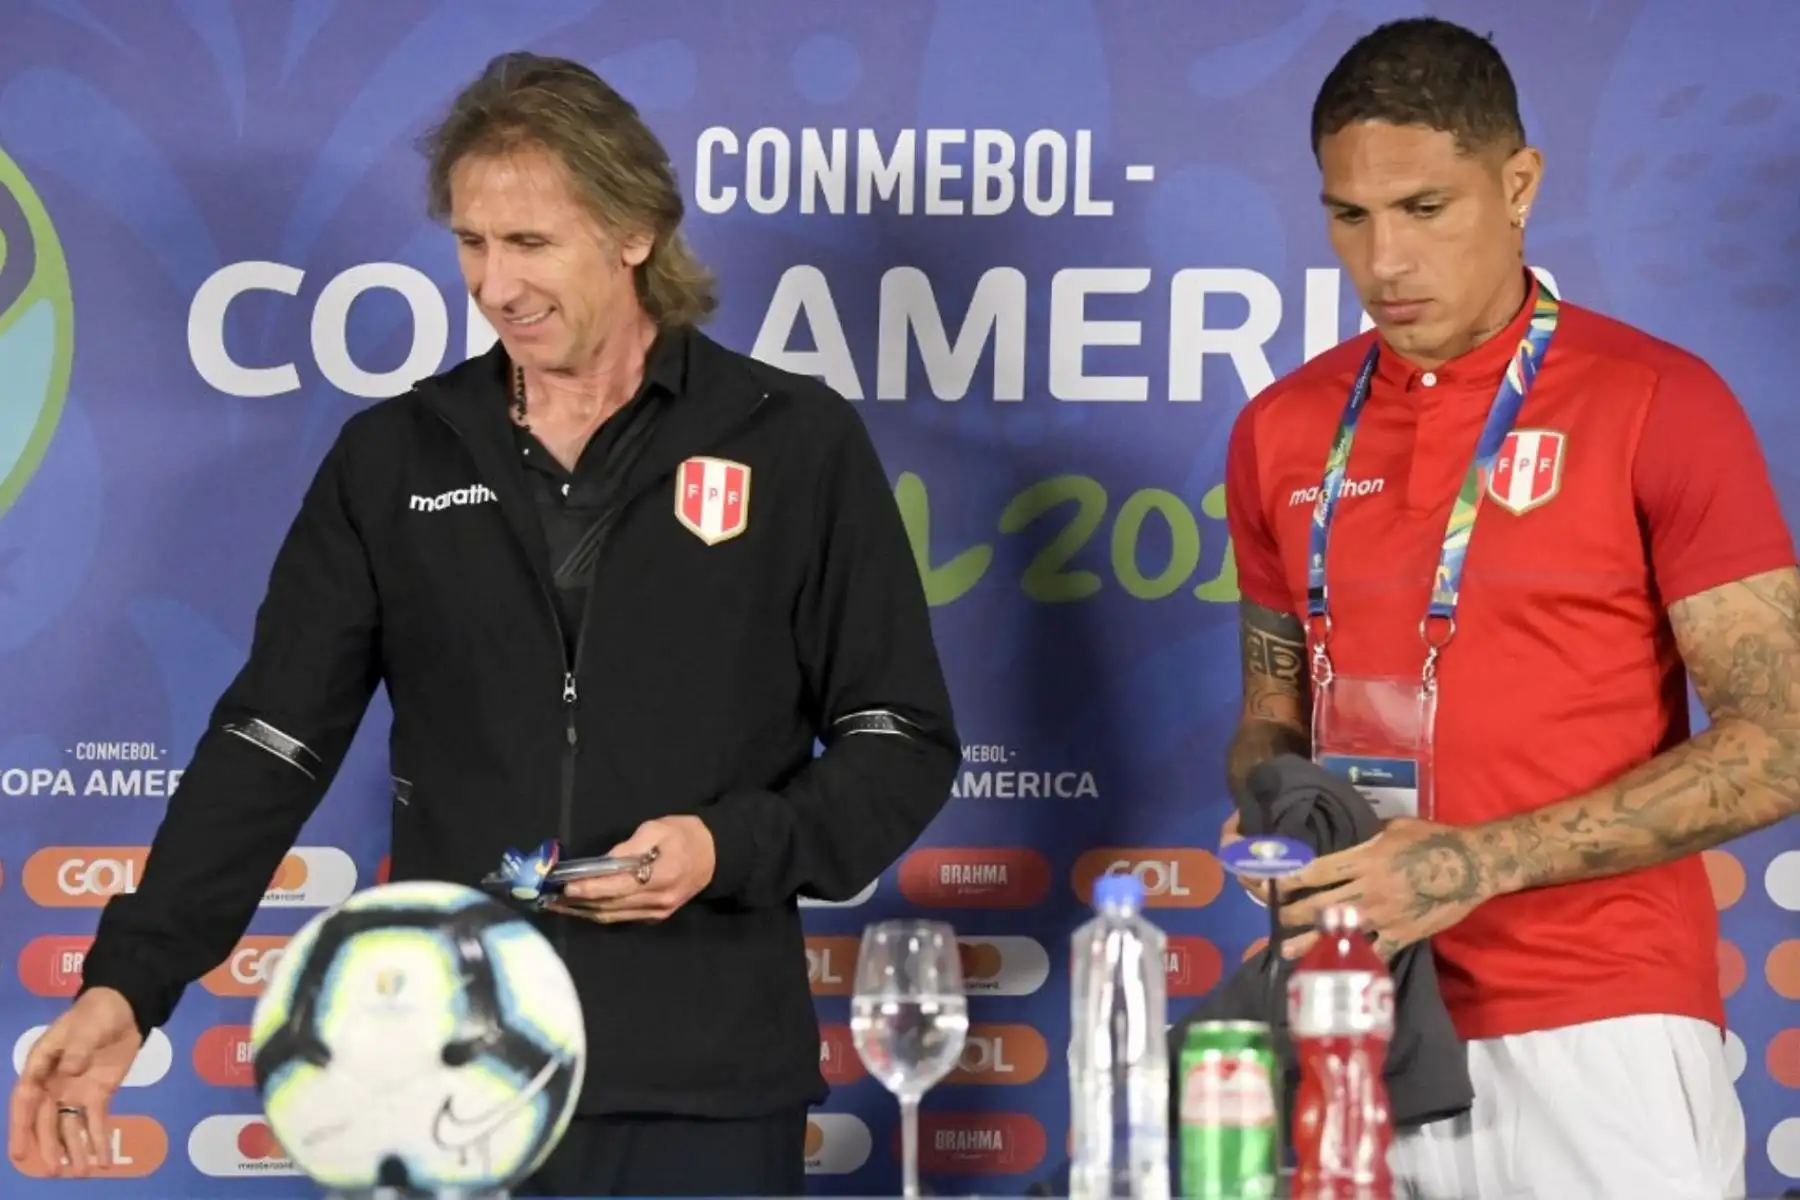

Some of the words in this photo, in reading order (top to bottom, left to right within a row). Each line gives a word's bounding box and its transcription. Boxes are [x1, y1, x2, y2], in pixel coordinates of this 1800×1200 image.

[695, 126, 1114, 216] CONMEBOL
[187, 261, 500, 398] CO
[750, 264, 1562, 401] AMERI
[409, 483, 498, 512] marath
[1288, 478, 1385, 507] mathon
[0, 768, 76, 796] OPA
[57, 858, 138, 895] GOL
[940, 864, 1008, 885] BRAHMA
[230, 948, 282, 985] GO
[956, 1036, 1014, 1073] OL
[935, 1130, 1003, 1150] BRAHMA
